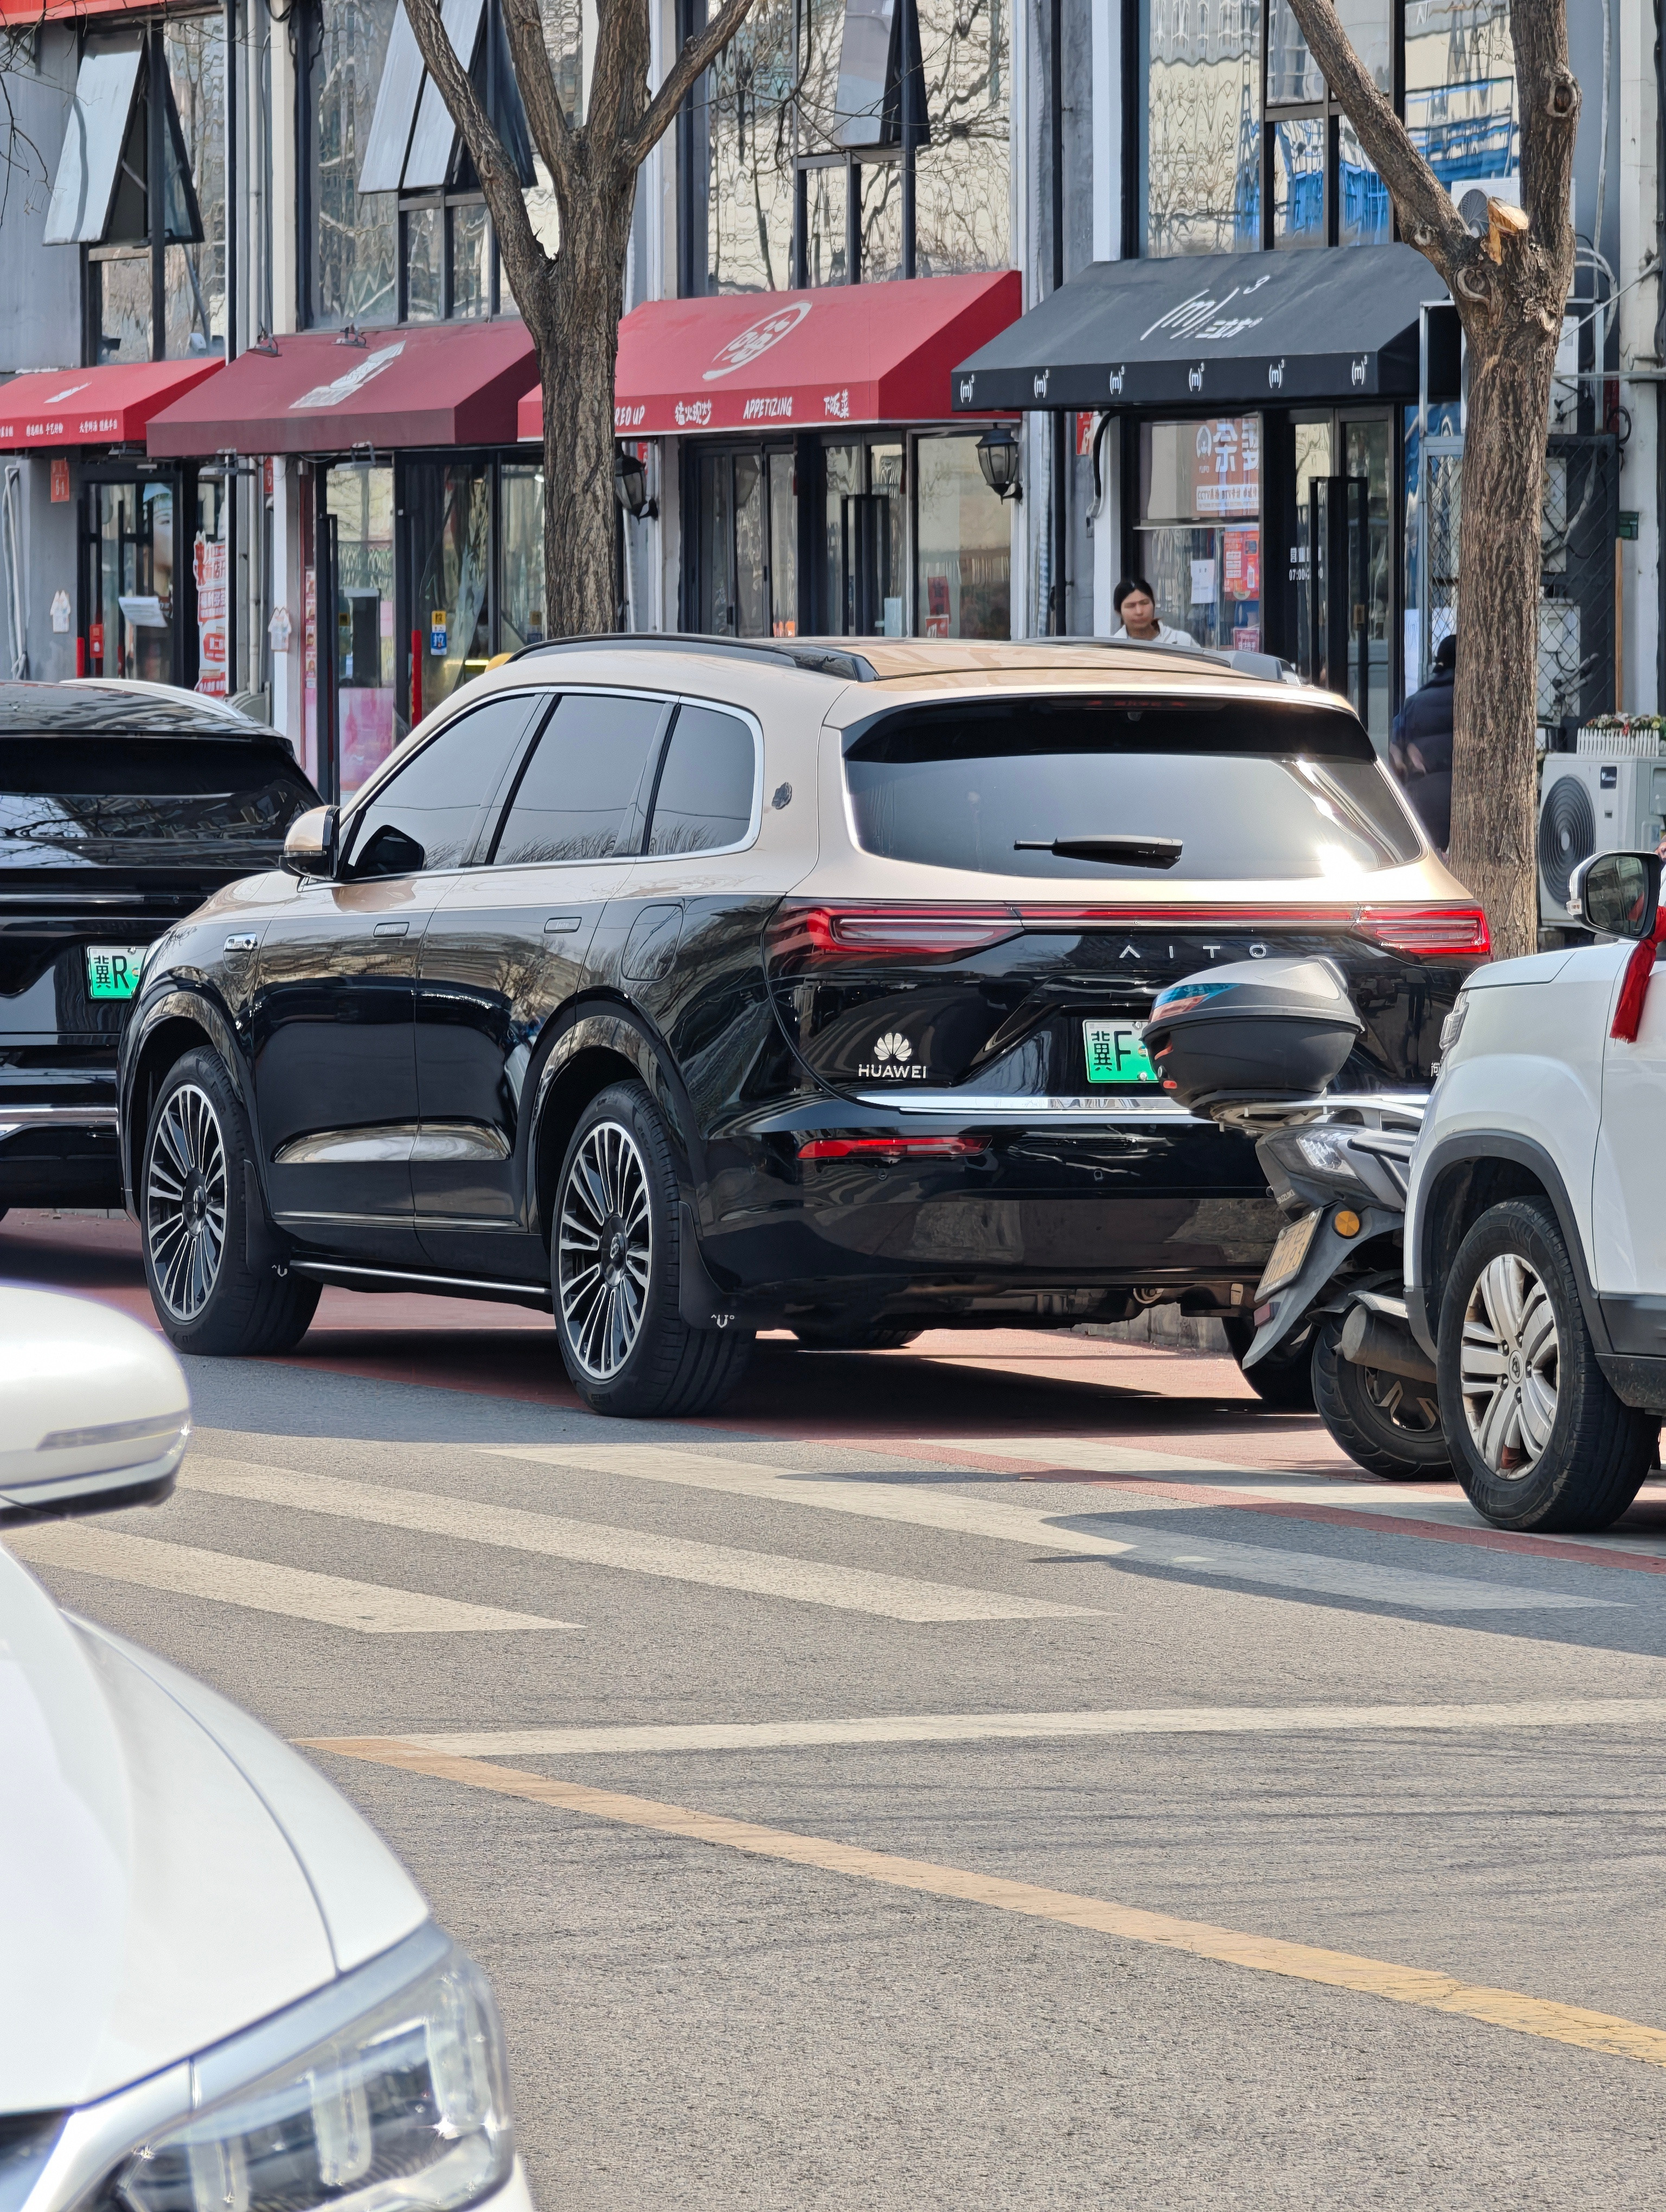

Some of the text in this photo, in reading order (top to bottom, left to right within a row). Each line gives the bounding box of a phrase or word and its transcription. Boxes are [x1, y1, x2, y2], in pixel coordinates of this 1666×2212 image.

[633, 404, 645, 425] UP
[675, 399, 712, 426] 猛火现炒
[743, 396, 792, 419] APPETIZING
[823, 388, 849, 419] 下饭菜
[1119, 944, 1267, 959] AITO
[93, 955, 130, 989] 冀R
[1091, 1031, 1132, 1071] 冀F
[858, 1064, 927, 1079] HUAWEI
